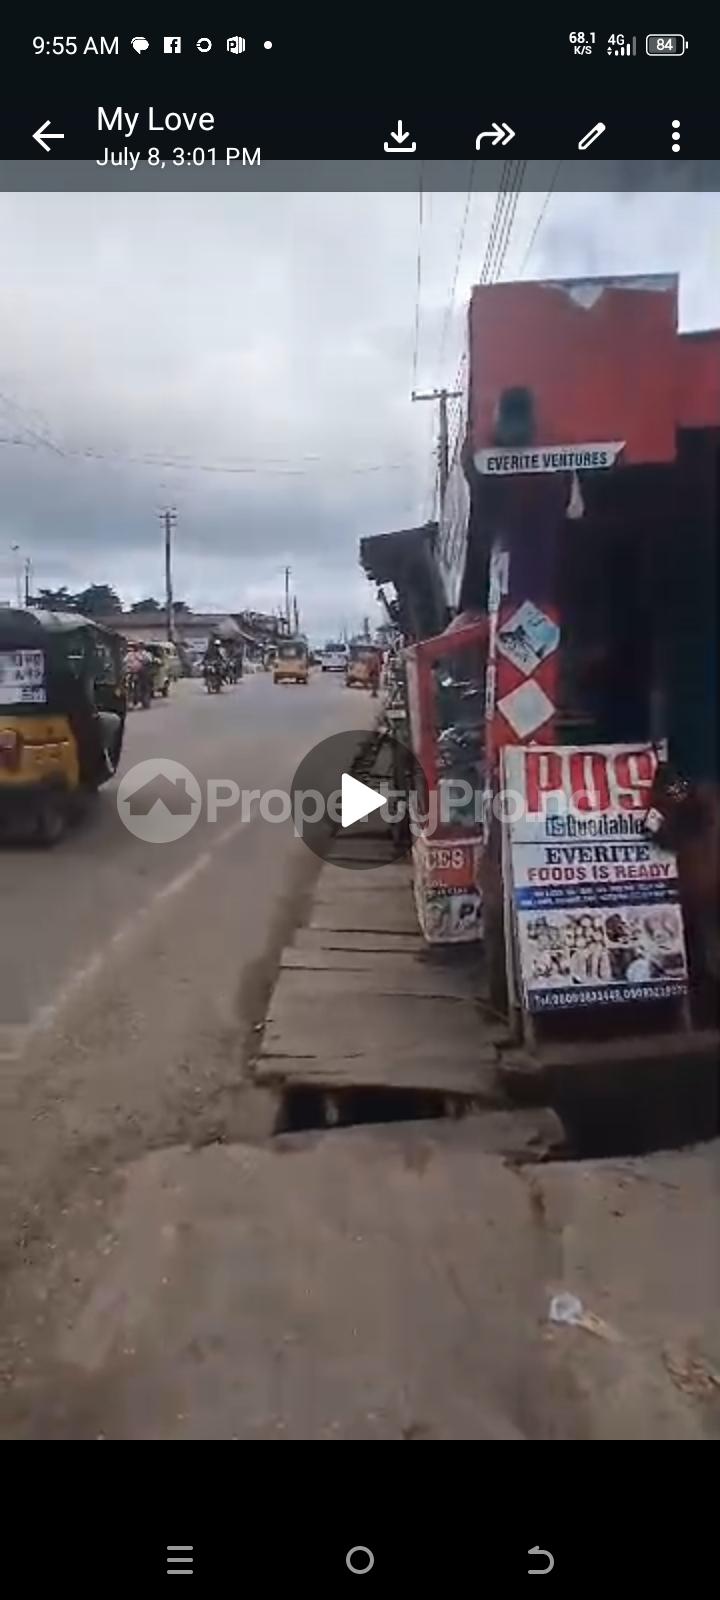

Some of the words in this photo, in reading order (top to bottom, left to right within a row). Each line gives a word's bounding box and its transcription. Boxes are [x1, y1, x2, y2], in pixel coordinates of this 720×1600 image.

[487, 453, 541, 471] EVERITE
[543, 451, 608, 468] VENTURES
[524, 751, 659, 814] POS
[545, 845, 650, 865] EVERITE
[527, 866, 587, 882] FOODS
[591, 865, 610, 880] IS
[615, 862, 671, 879] READY
